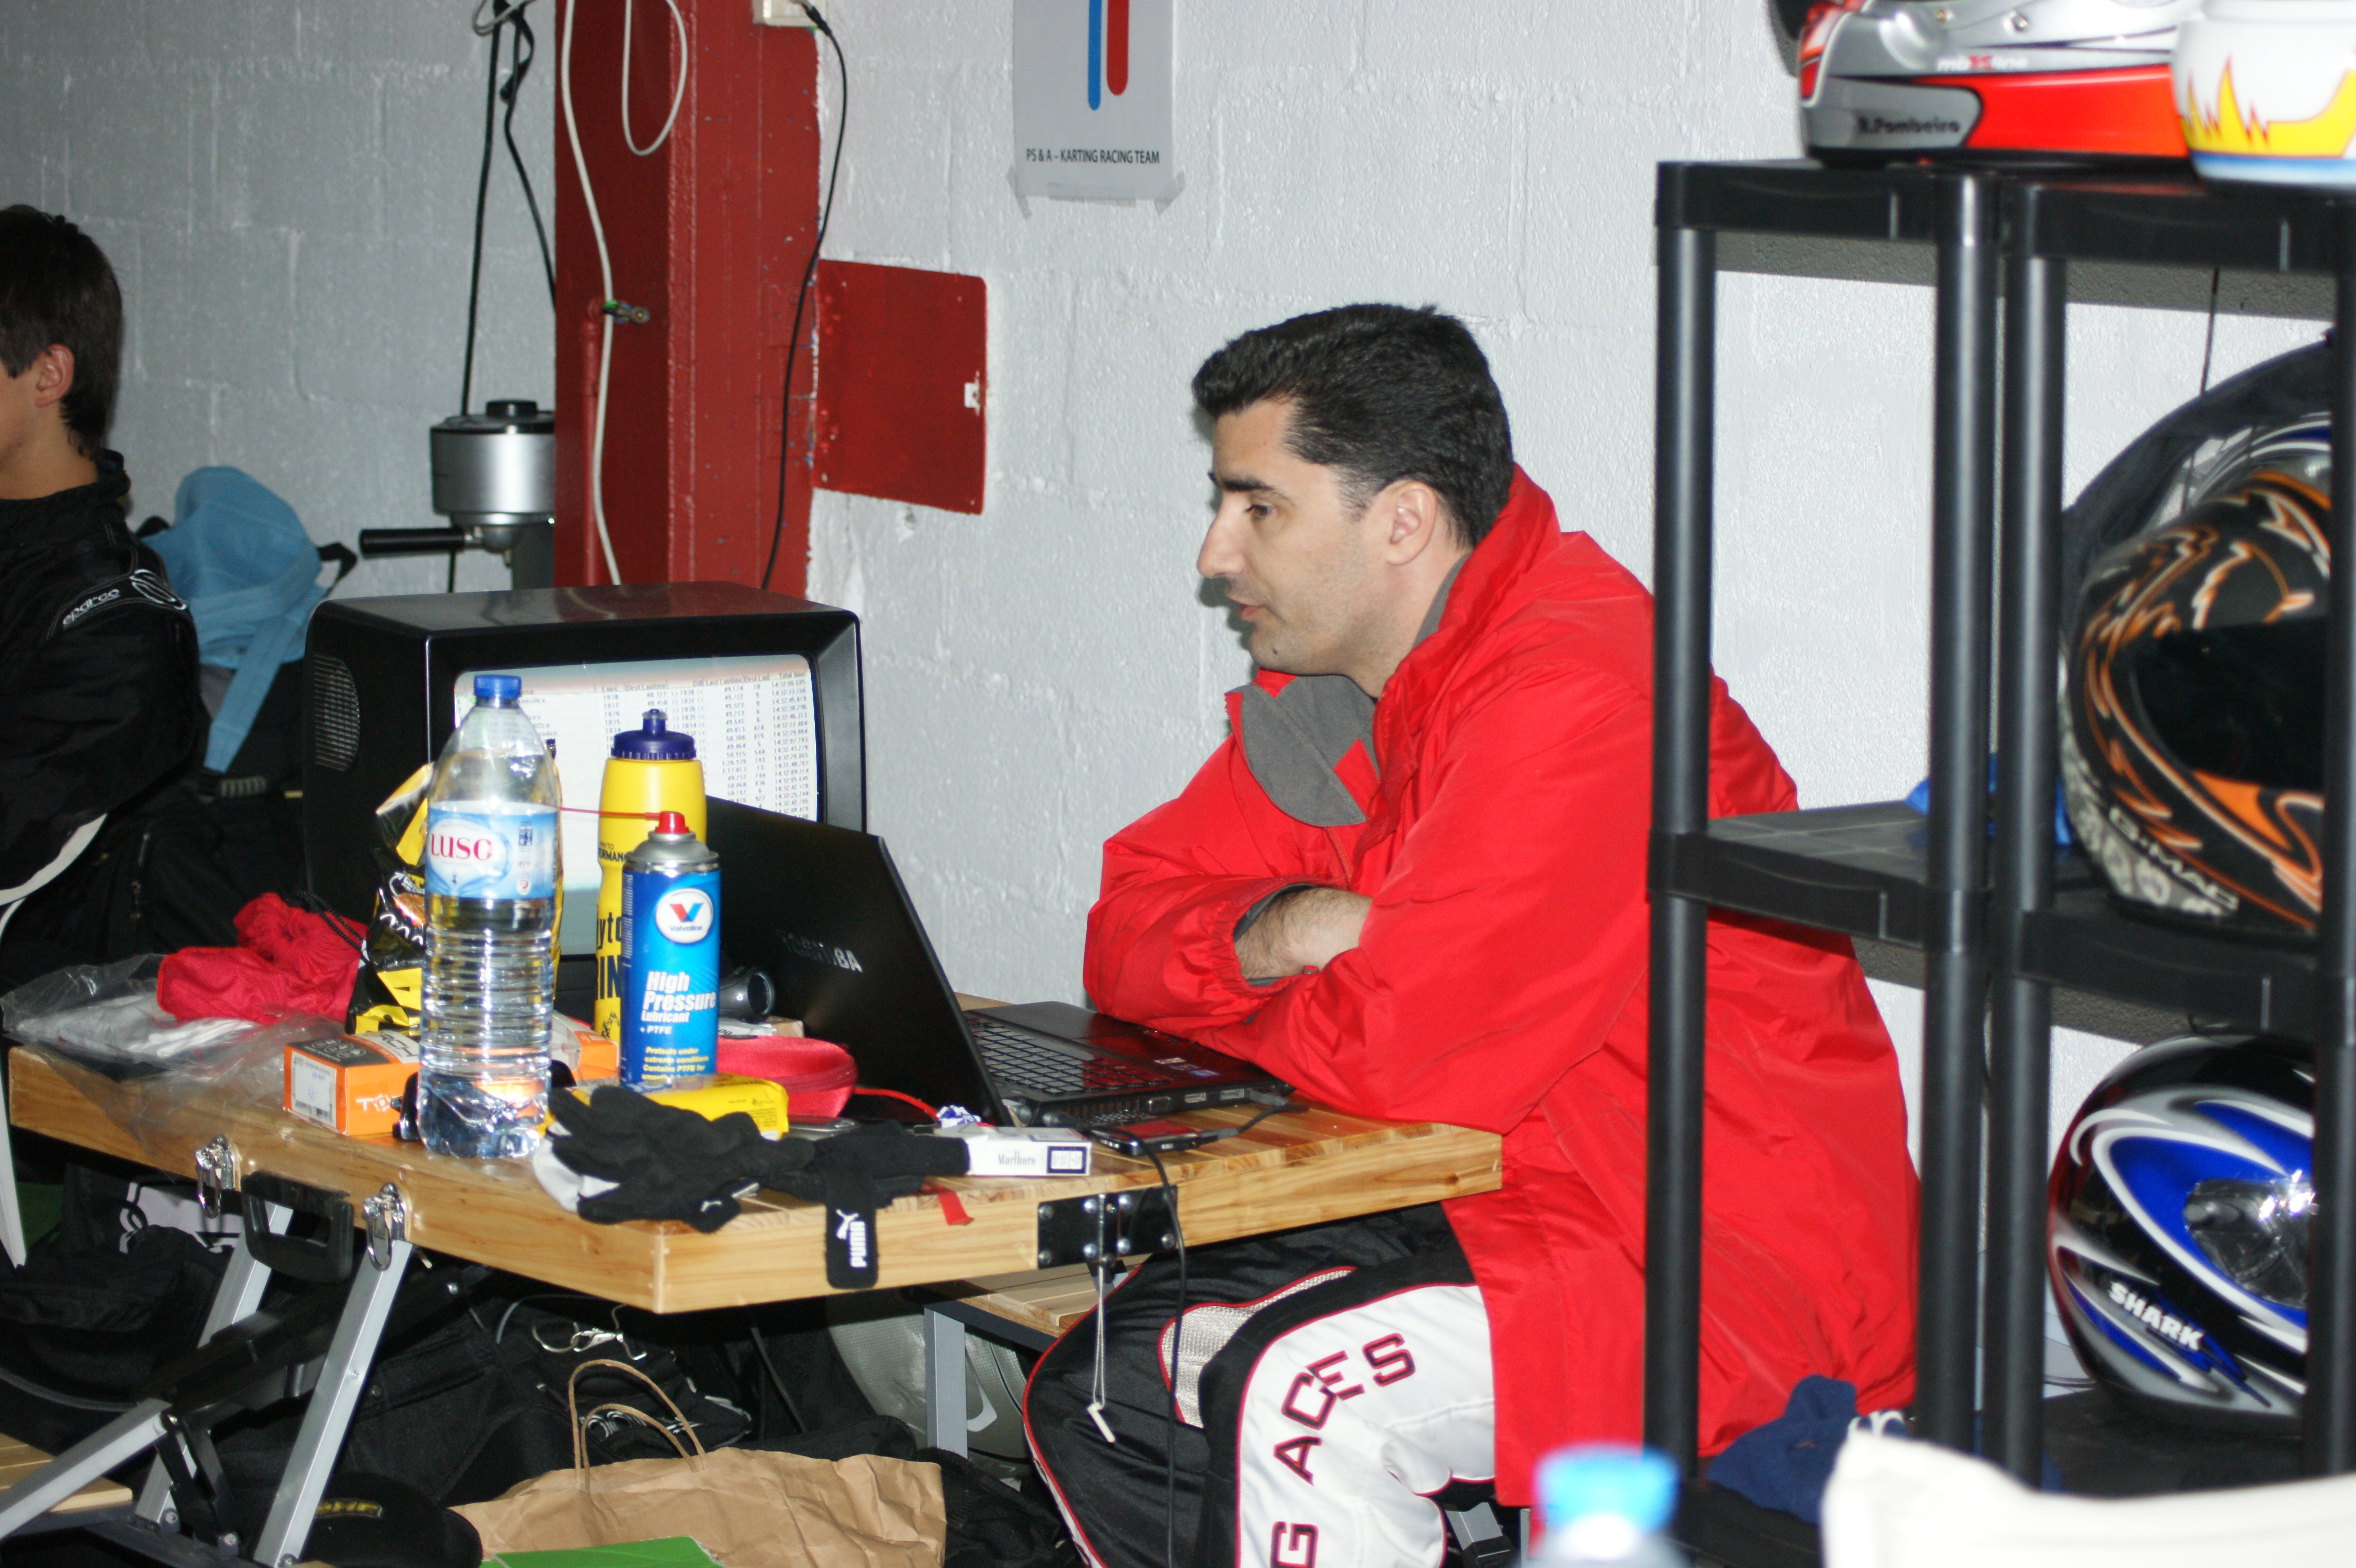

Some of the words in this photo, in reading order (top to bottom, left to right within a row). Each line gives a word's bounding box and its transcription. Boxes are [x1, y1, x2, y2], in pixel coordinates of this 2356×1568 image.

[1026, 148, 1036, 162] PS
[1038, 148, 1044, 162] &
[1046, 148, 1053, 162] A
[1060, 148, 1098, 163] KARTING
[1100, 149, 1133, 164] RACING
[1135, 150, 1160, 164] TEAM
[646, 970, 691, 994] High
[642, 990, 716, 1012] Pressure
[641, 1010, 690, 1023] Lubricant
[646, 1025, 672, 1034] PTFE
[997, 1150, 1036, 1165] Marlboro
[850, 1220, 867, 1267] PUMA
[2107, 1280, 2204, 1351] SHARK
